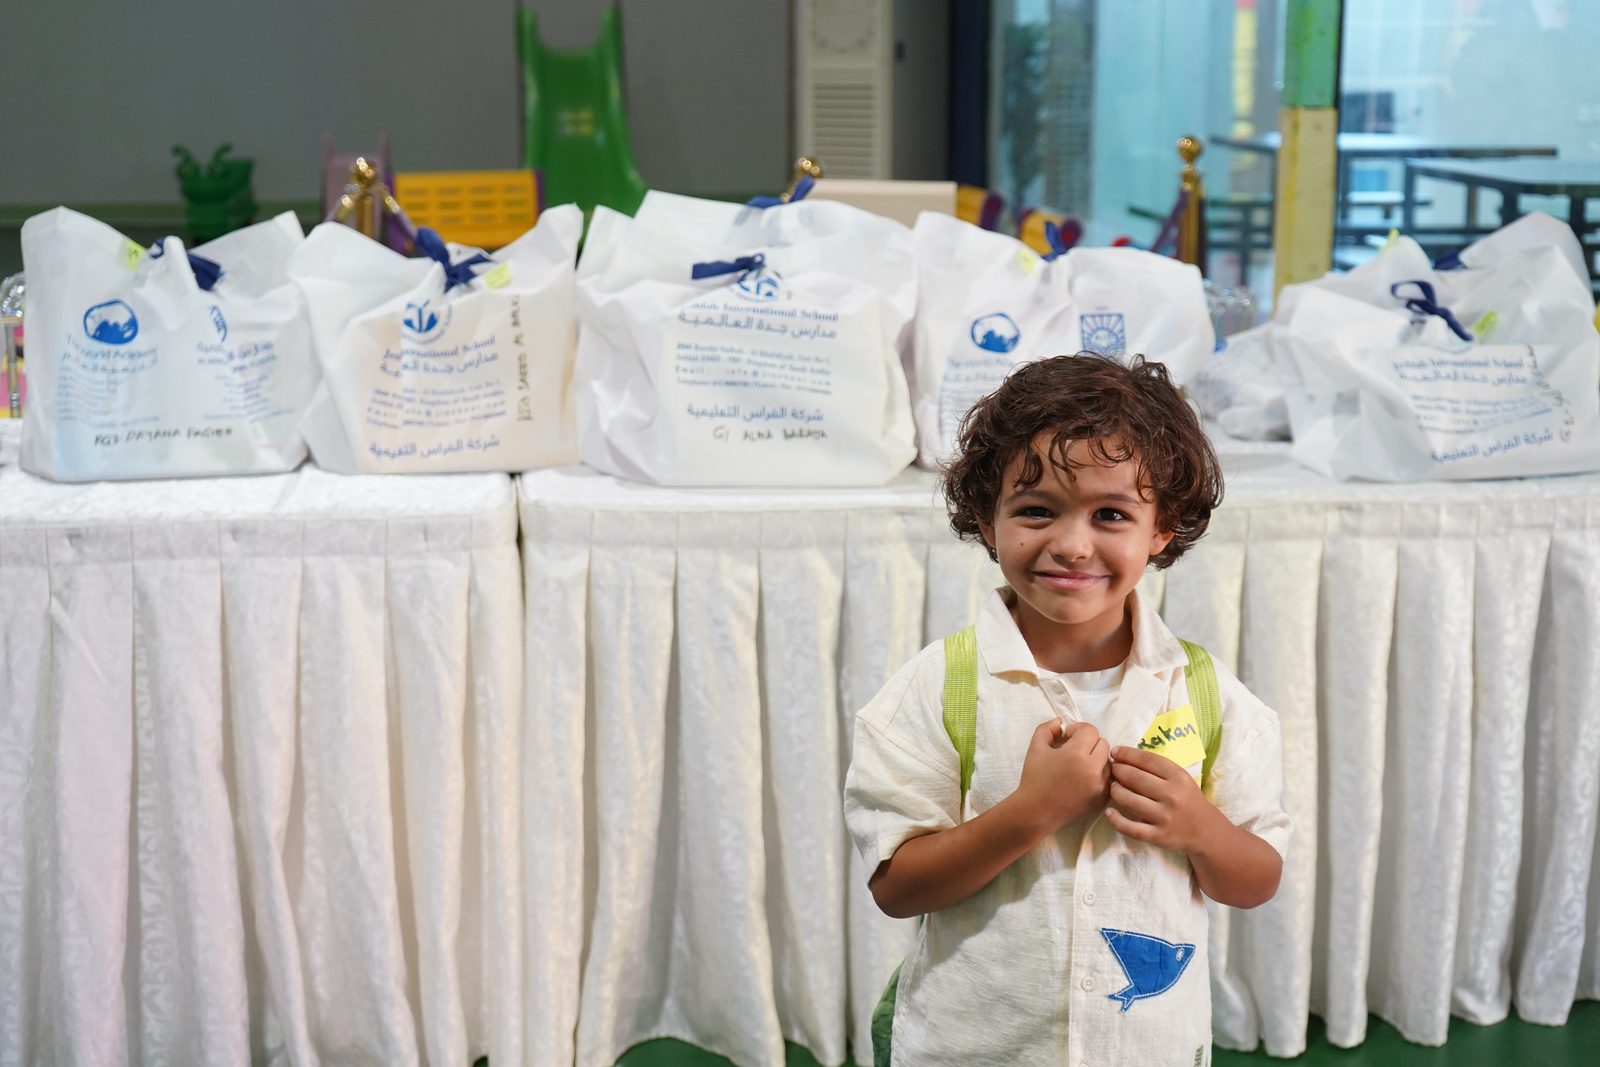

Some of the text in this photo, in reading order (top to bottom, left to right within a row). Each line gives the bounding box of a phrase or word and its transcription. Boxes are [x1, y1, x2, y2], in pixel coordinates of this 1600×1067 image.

[723, 303, 797, 319] International
[801, 309, 839, 322] School
[677, 311, 837, 340] مدارس جدة العالمية
